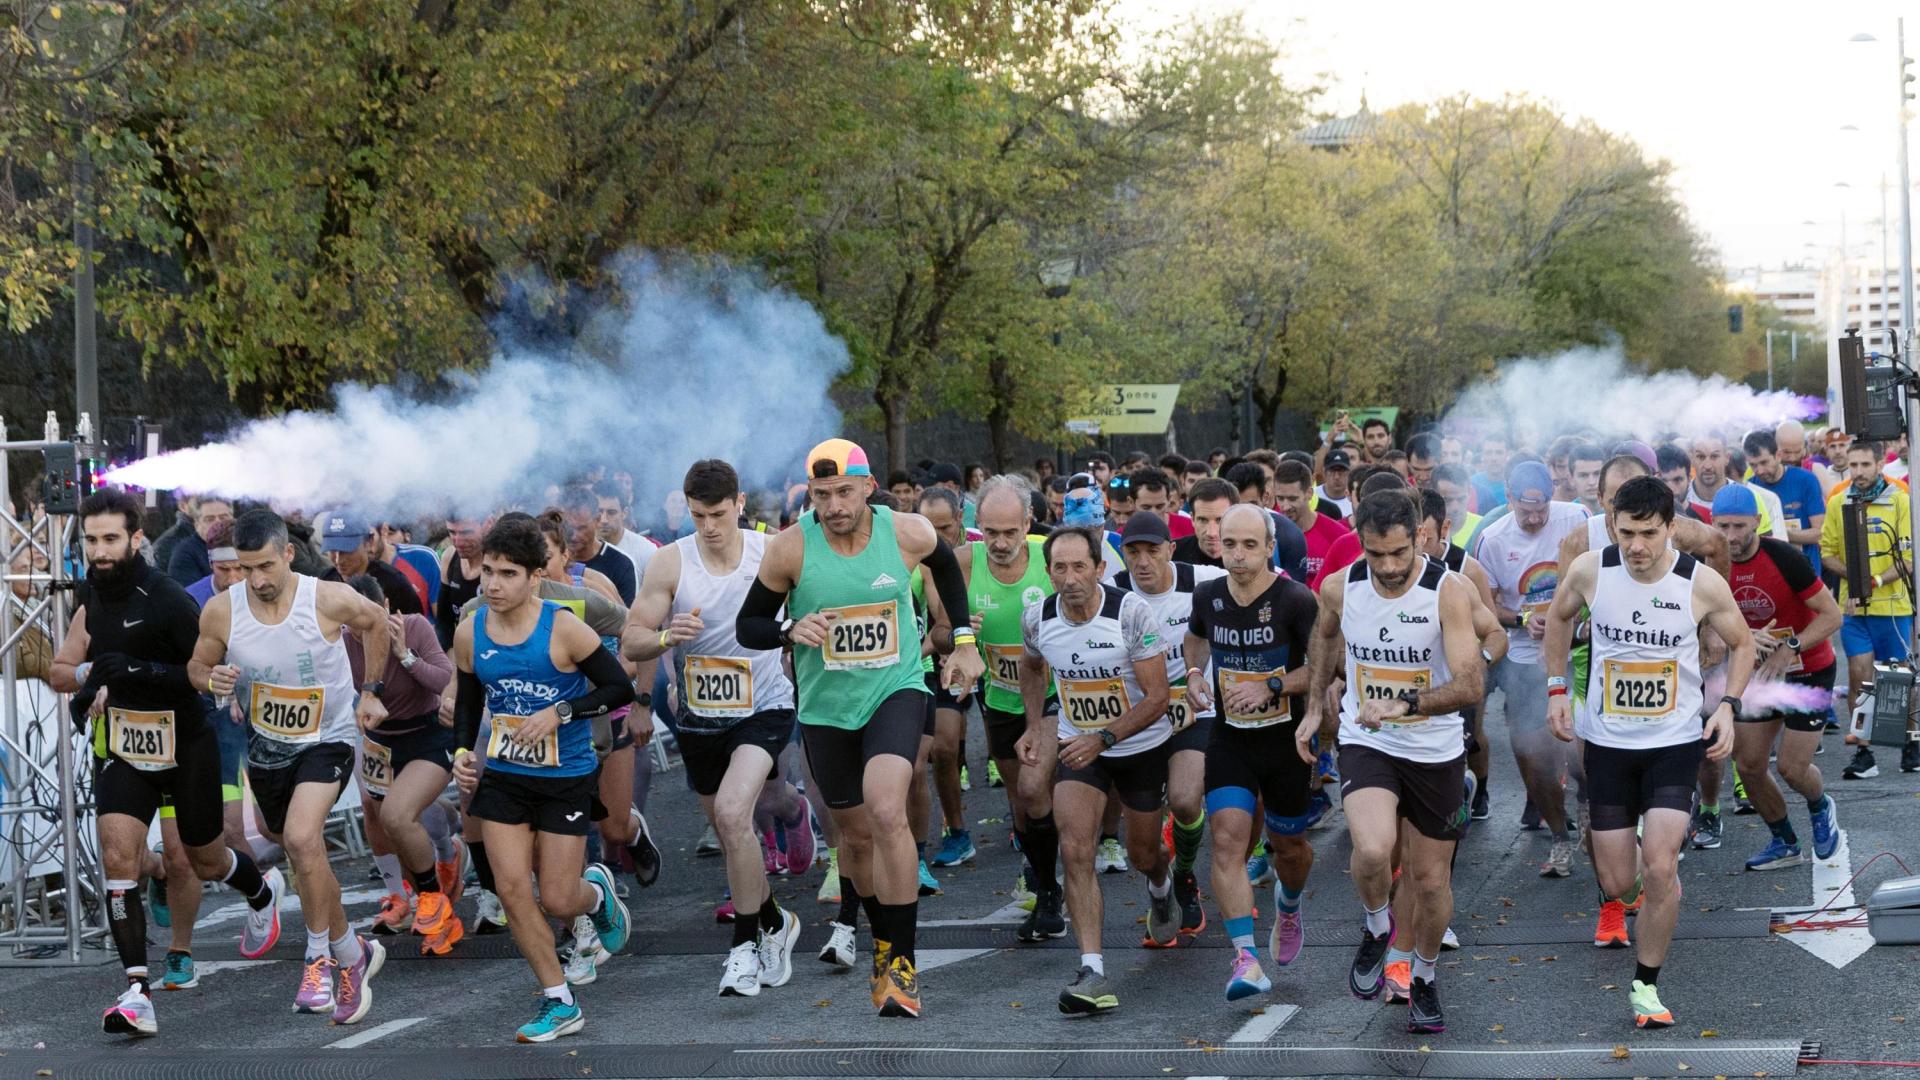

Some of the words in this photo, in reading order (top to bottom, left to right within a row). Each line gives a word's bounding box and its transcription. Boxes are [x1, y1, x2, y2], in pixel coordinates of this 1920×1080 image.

[1113, 386, 1125, 405] 3
[834, 621, 888, 653] 21259
[696, 674, 740, 701] 21201
[1615, 679, 1668, 708] 21225
[263, 701, 310, 729] 21160
[1069, 695, 1123, 722] 21040
[122, 727, 164, 756] 21281
